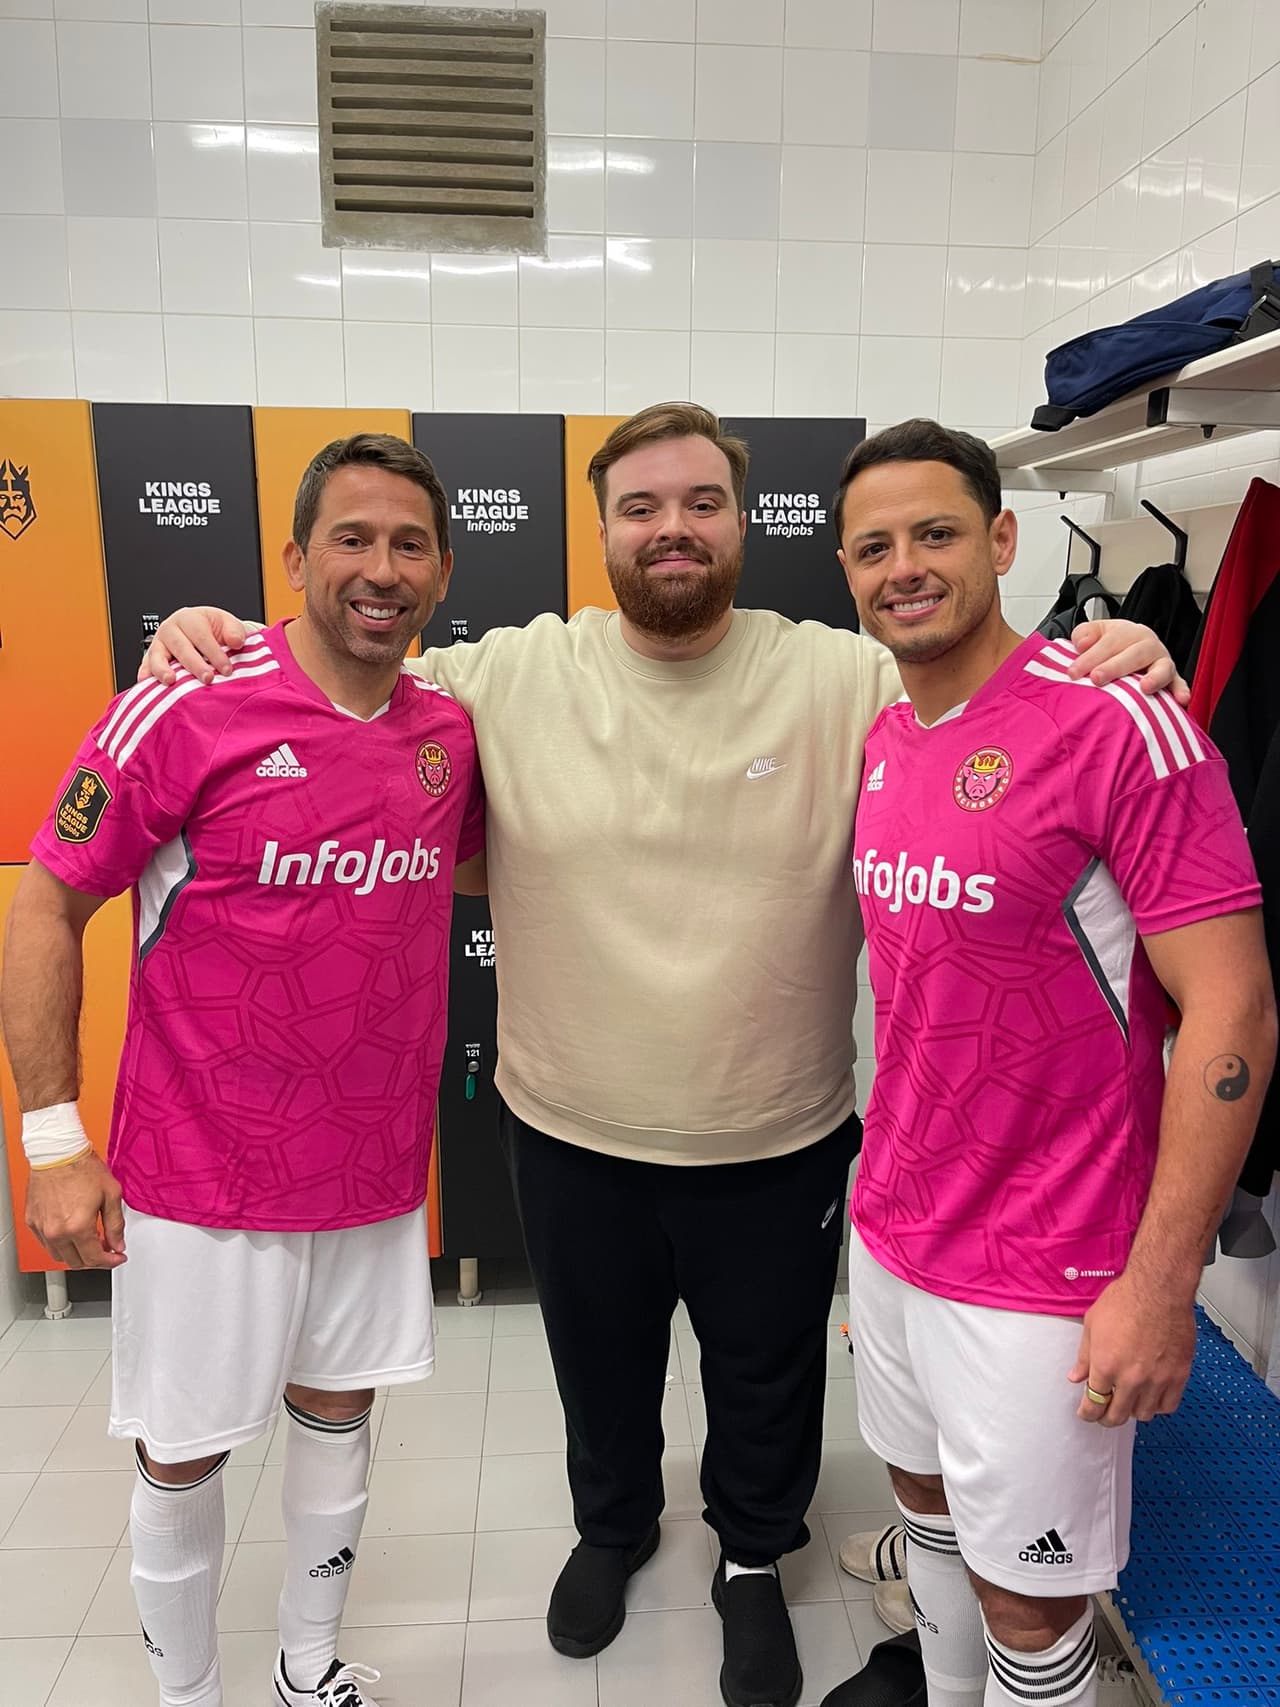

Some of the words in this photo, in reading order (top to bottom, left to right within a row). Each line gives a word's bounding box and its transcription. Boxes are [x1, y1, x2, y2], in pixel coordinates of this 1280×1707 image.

[145, 481, 211, 497] KINGS
[458, 488, 521, 504] KINGS
[139, 498, 220, 513] LEAGUE
[759, 493, 820, 508] KINGS
[450, 504, 529, 519] LEAGUE
[751, 509, 827, 524] LEAGUE
[157, 514, 208, 528] InfoJobs
[467, 519, 517, 534] InfoJobs
[766, 524, 814, 538] InfoJobs
[143, 621, 160, 630] 113
[452, 626, 468, 635] 115
[255, 764, 308, 778] adidas
[751, 757, 776, 771] NIKE
[60, 807, 88, 834] LEAGUE
[64, 802, 89, 825] KINGS
[257, 838, 441, 896] InfoJobs
[465, 1049, 480, 1057] 121
[1018, 1550, 1073, 1565] adidas
